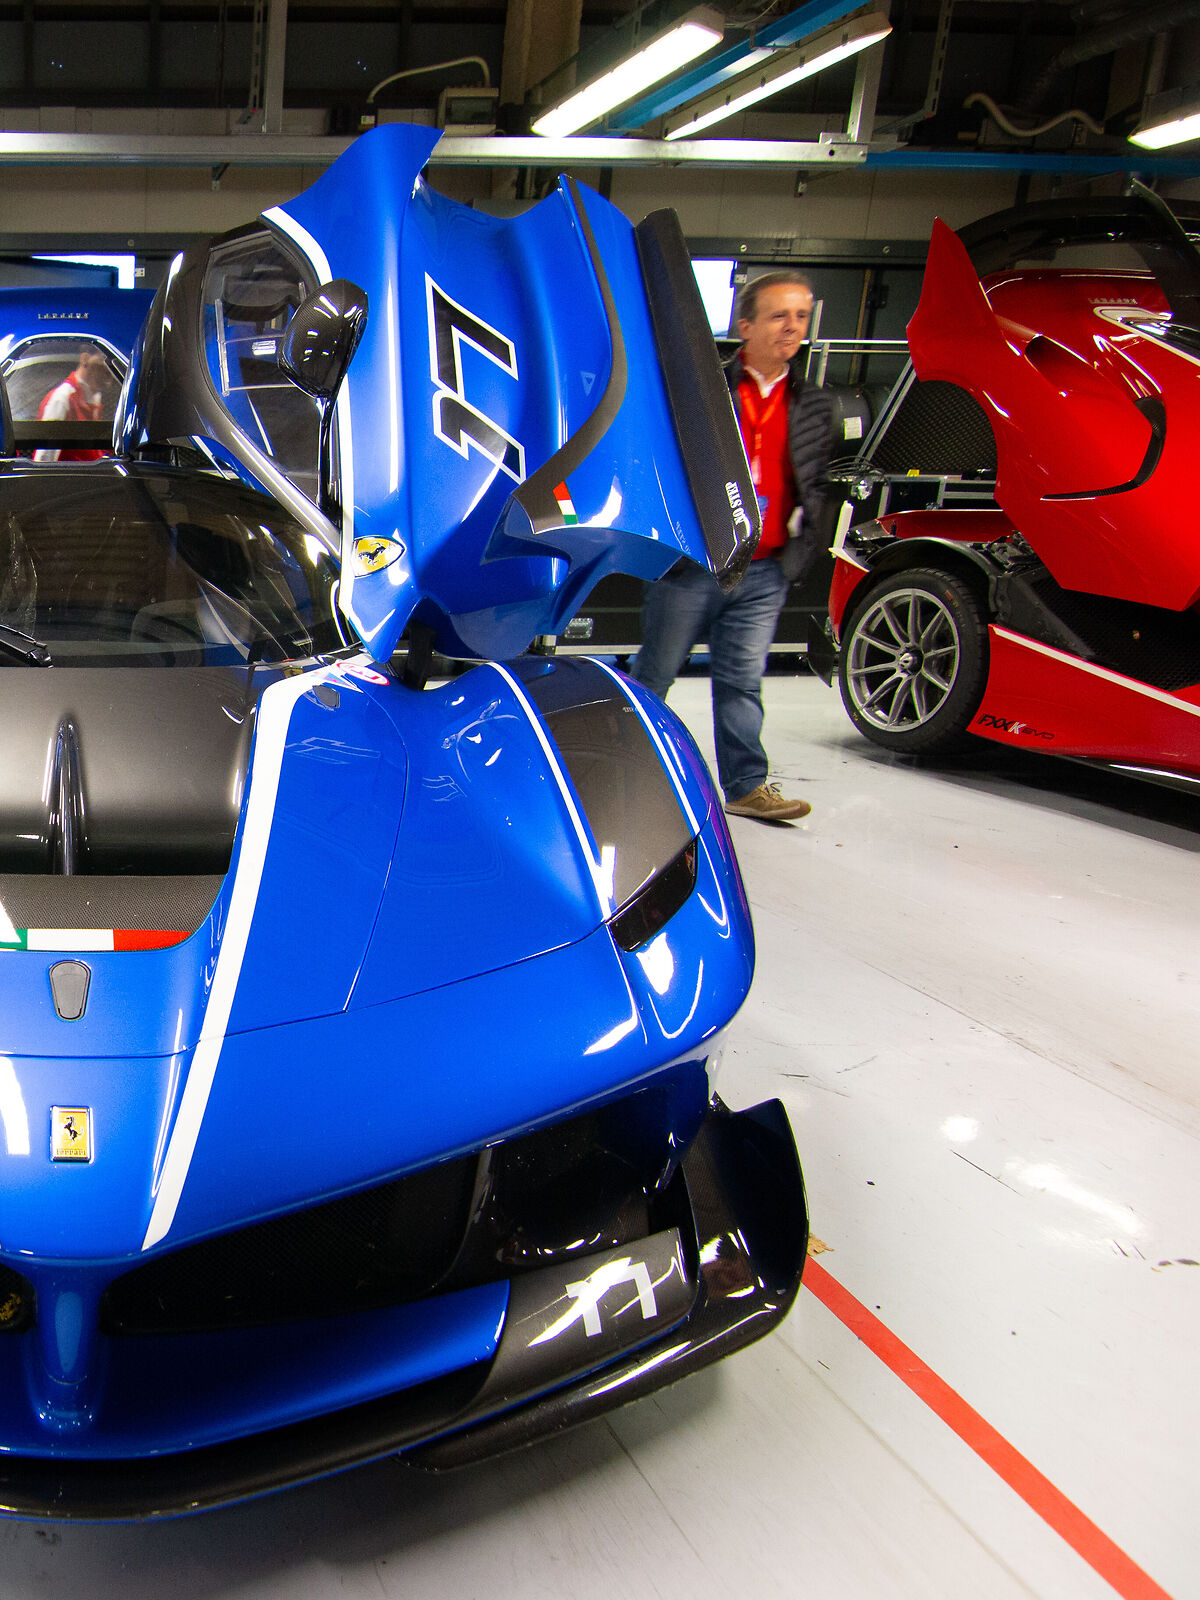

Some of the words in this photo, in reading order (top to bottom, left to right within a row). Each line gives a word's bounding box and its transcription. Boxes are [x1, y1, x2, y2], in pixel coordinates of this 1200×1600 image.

[424, 271, 527, 485] 17
[725, 481, 743, 509] STEP
[732, 507, 745, 525] NO
[565, 1258, 658, 1338] 17
